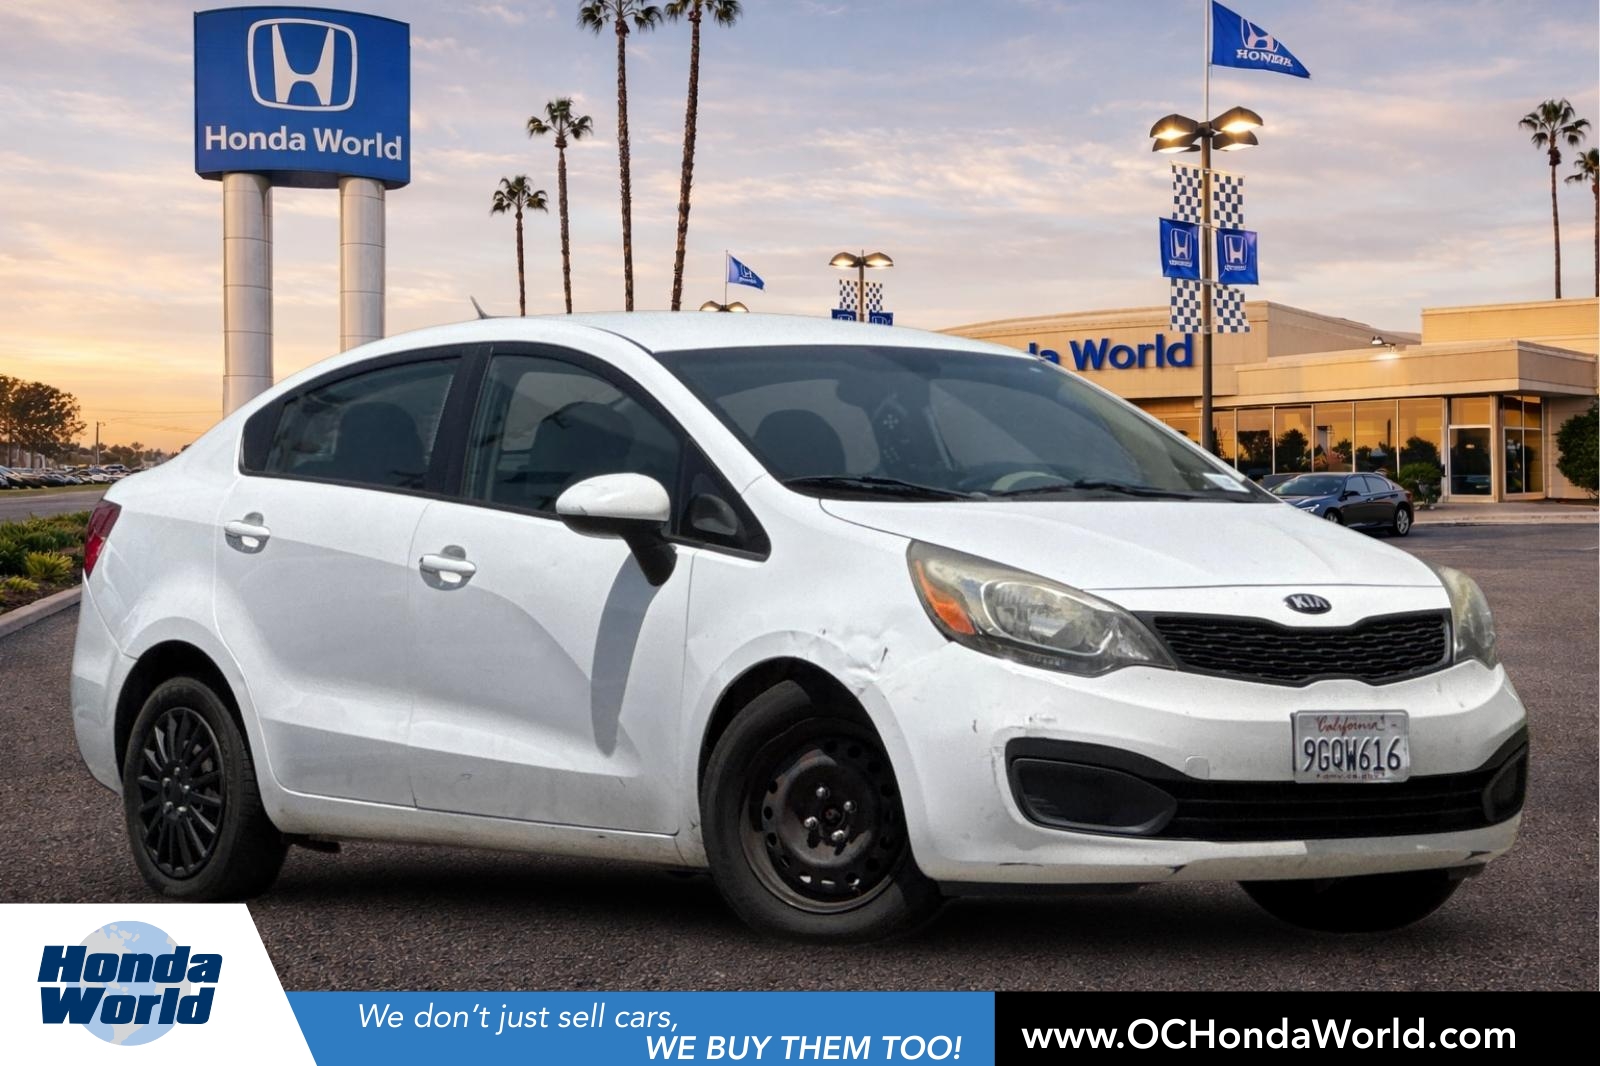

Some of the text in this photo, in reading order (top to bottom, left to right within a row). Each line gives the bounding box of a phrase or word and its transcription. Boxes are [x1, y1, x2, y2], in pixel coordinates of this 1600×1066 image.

[205, 125, 402, 160] Honda World
[1070, 333, 1193, 371] World
[1292, 595, 1328, 609] KIA
[1317, 715, 1382, 736] California
[1303, 736, 1401, 773] 9GQW616
